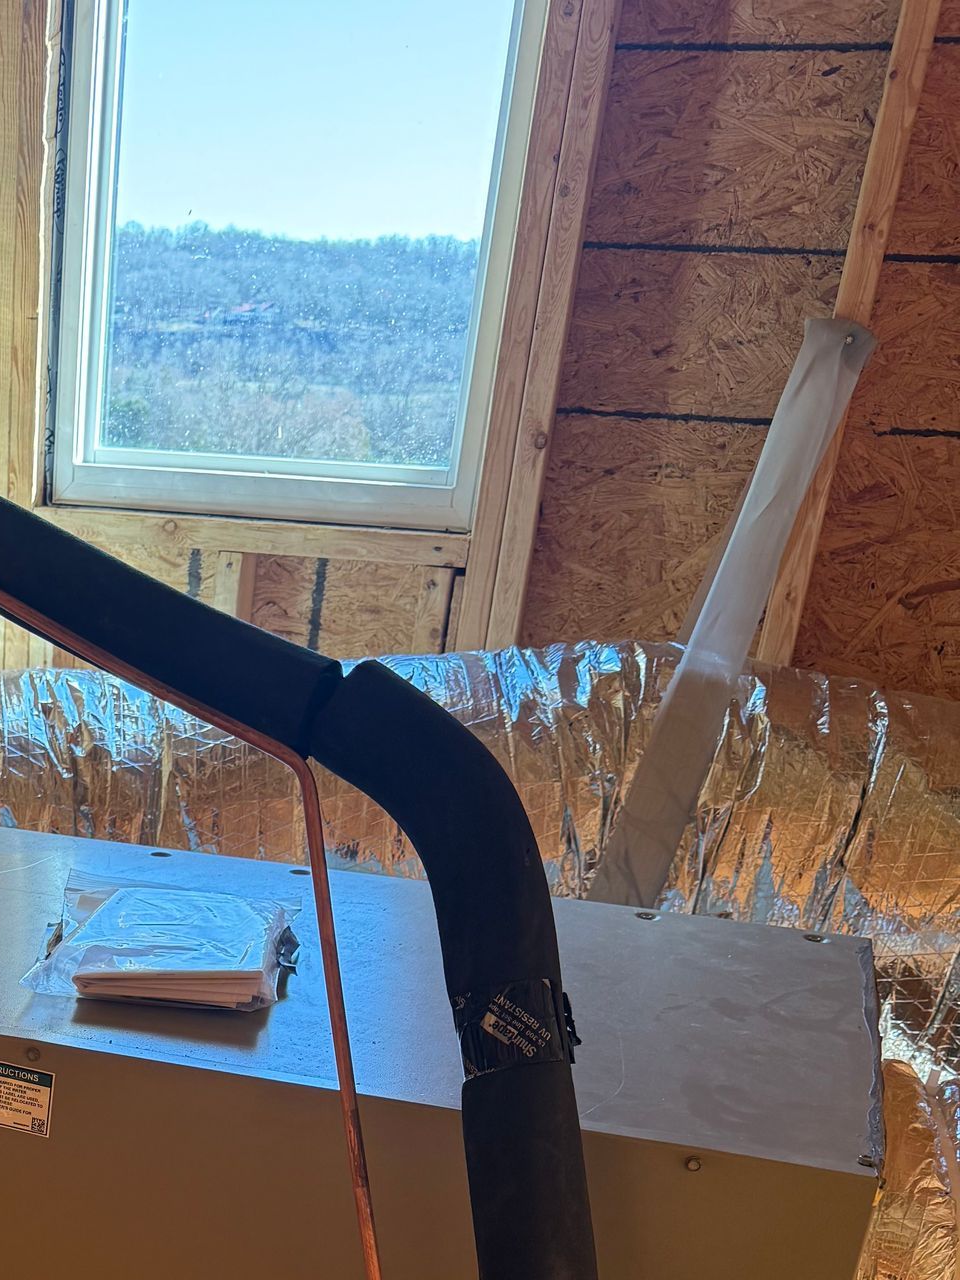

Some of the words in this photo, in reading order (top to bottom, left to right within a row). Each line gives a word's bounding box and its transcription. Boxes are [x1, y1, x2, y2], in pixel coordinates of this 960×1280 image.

[493, 993, 539, 1030] RESISTANT
[492, 1020, 537, 1057] Shurtape
[539, 1028, 551, 1040] UV
